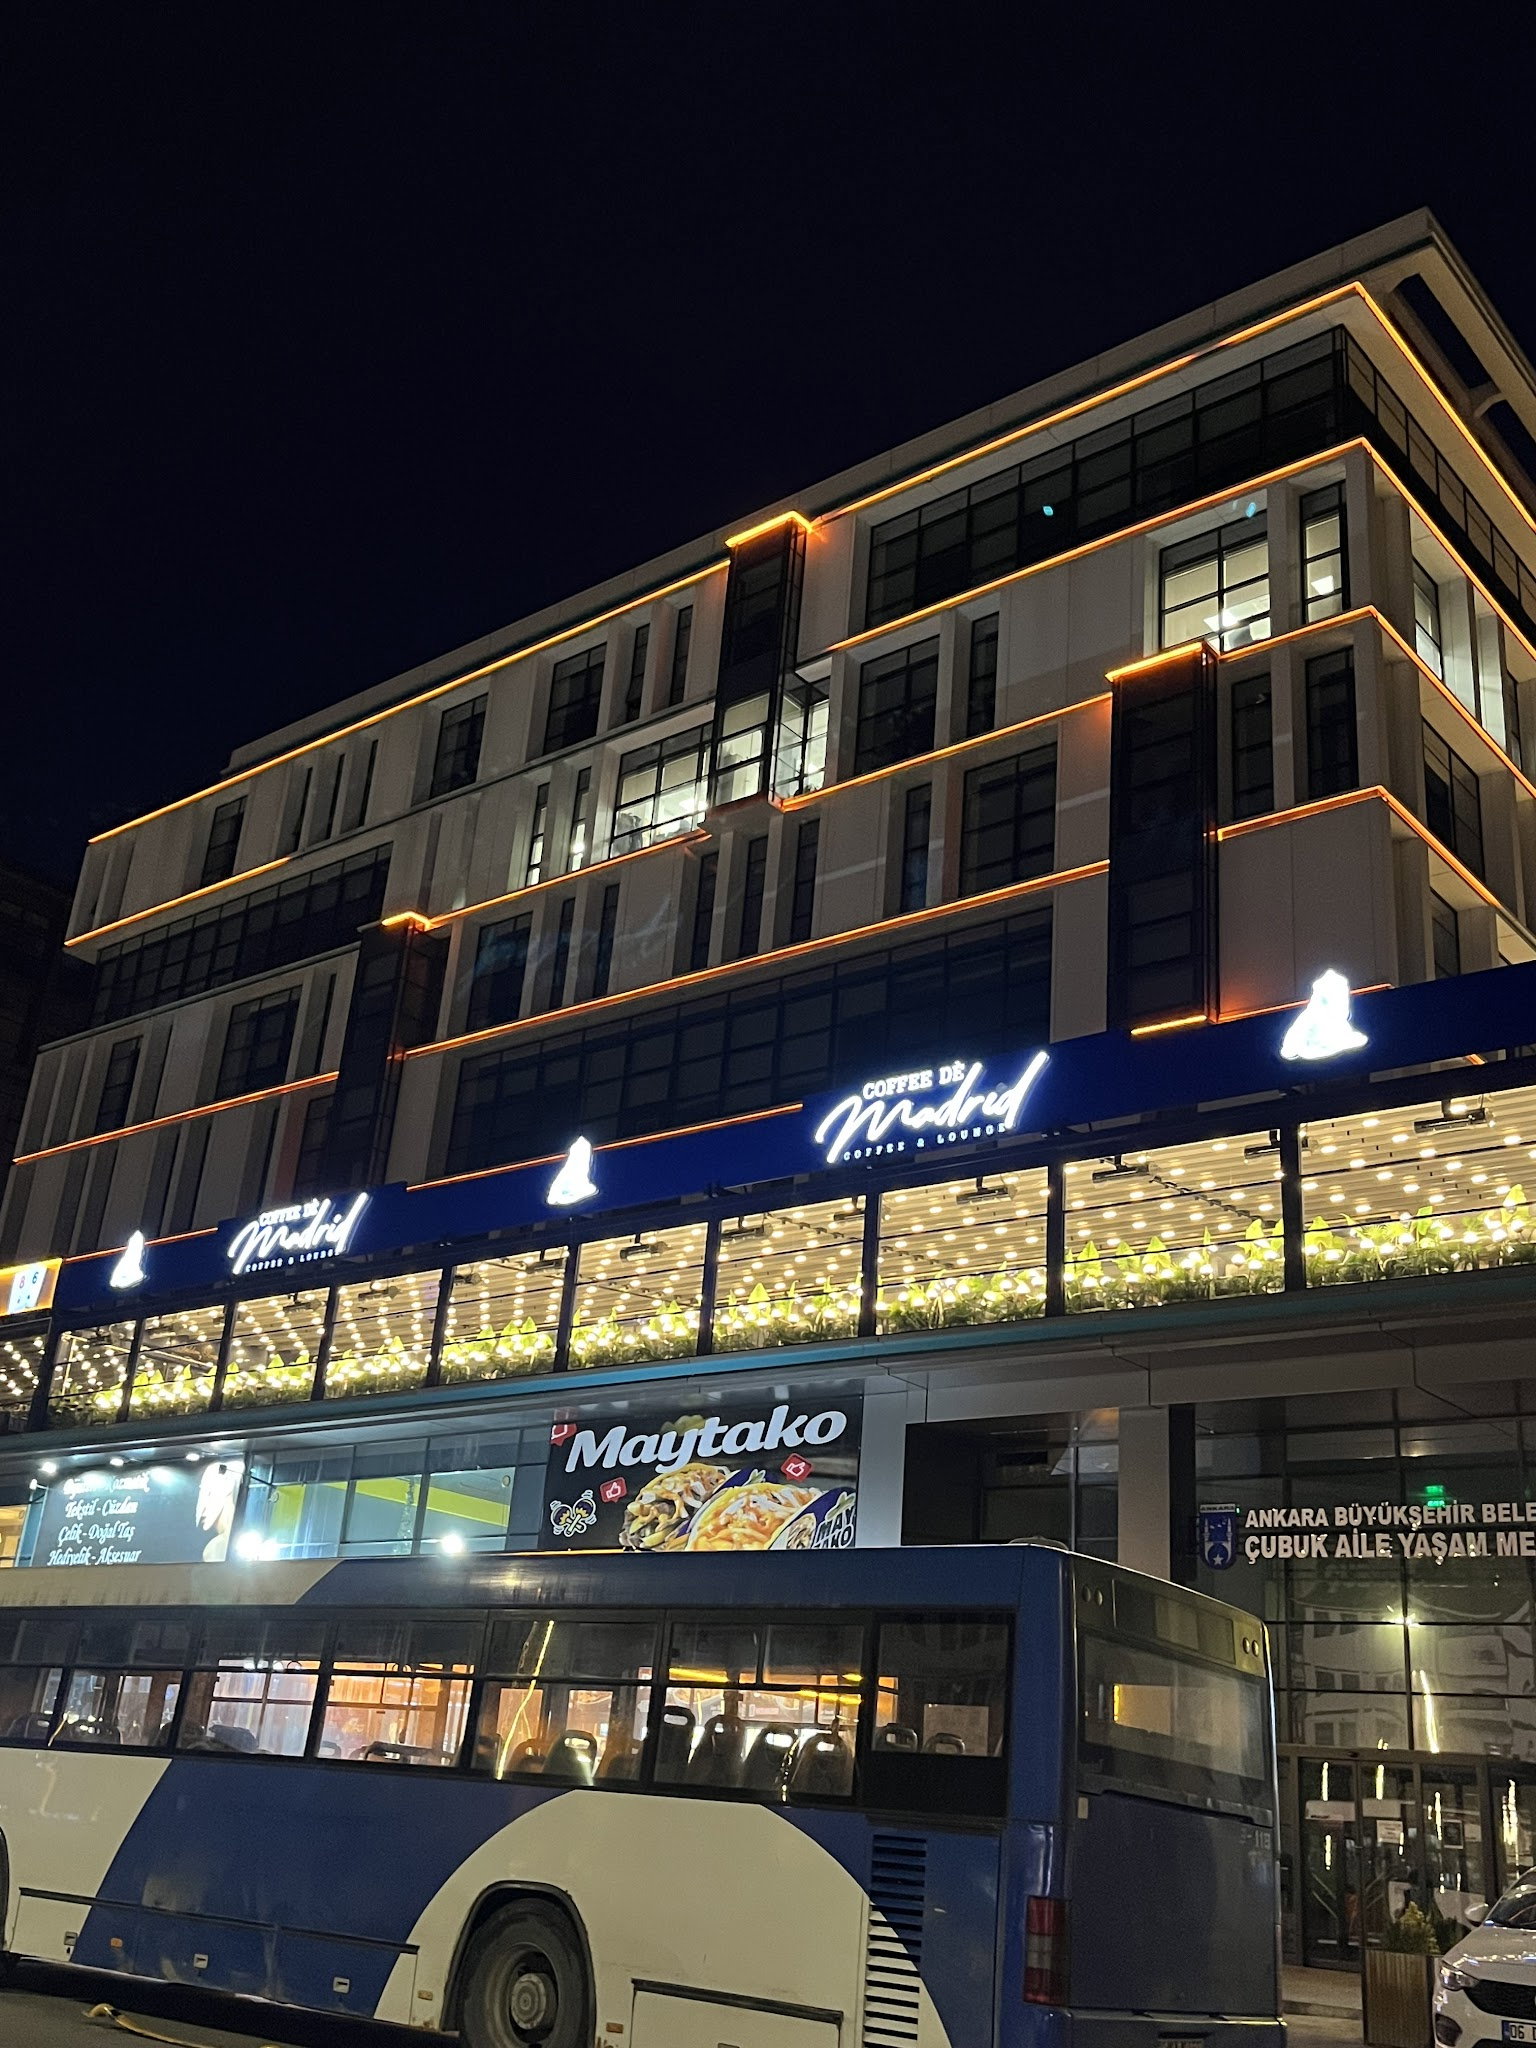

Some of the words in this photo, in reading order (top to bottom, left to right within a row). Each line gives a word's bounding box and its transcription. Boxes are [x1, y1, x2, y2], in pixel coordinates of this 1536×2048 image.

[863, 1069, 933, 1100] COFFEE
[814, 1050, 1050, 1164] Madrid
[843, 1141, 905, 1161] COFFEE
[937, 1123, 1006, 1144] LOUNGE
[259, 1205, 302, 1226] COFFEE
[226, 1192, 369, 1275] Madrid
[245, 1257, 283, 1273] COFFEE
[565, 1405, 848, 1474] Maytako
[65, 1498, 99, 1520] Tekstil
[1245, 1508, 1329, 1528] ANKARA
[1334, 1500, 1476, 1531] BÜYÜKŞEHİR
[1481, 1502, 1536, 1523] BELE
[88, 1520, 120, 1544] Doğal
[117, 1521, 136, 1542] Taş
[1245, 1533, 1328, 1564] ÇUBUK
[1334, 1528, 1393, 1559] AİLE
[1397, 1531, 1487, 1565] YAŞAM
[1496, 1531, 1536, 1557] ME
[95, 1545, 142, 1566] Aksesuar
[1510, 2024, 1525, 2040] 06
